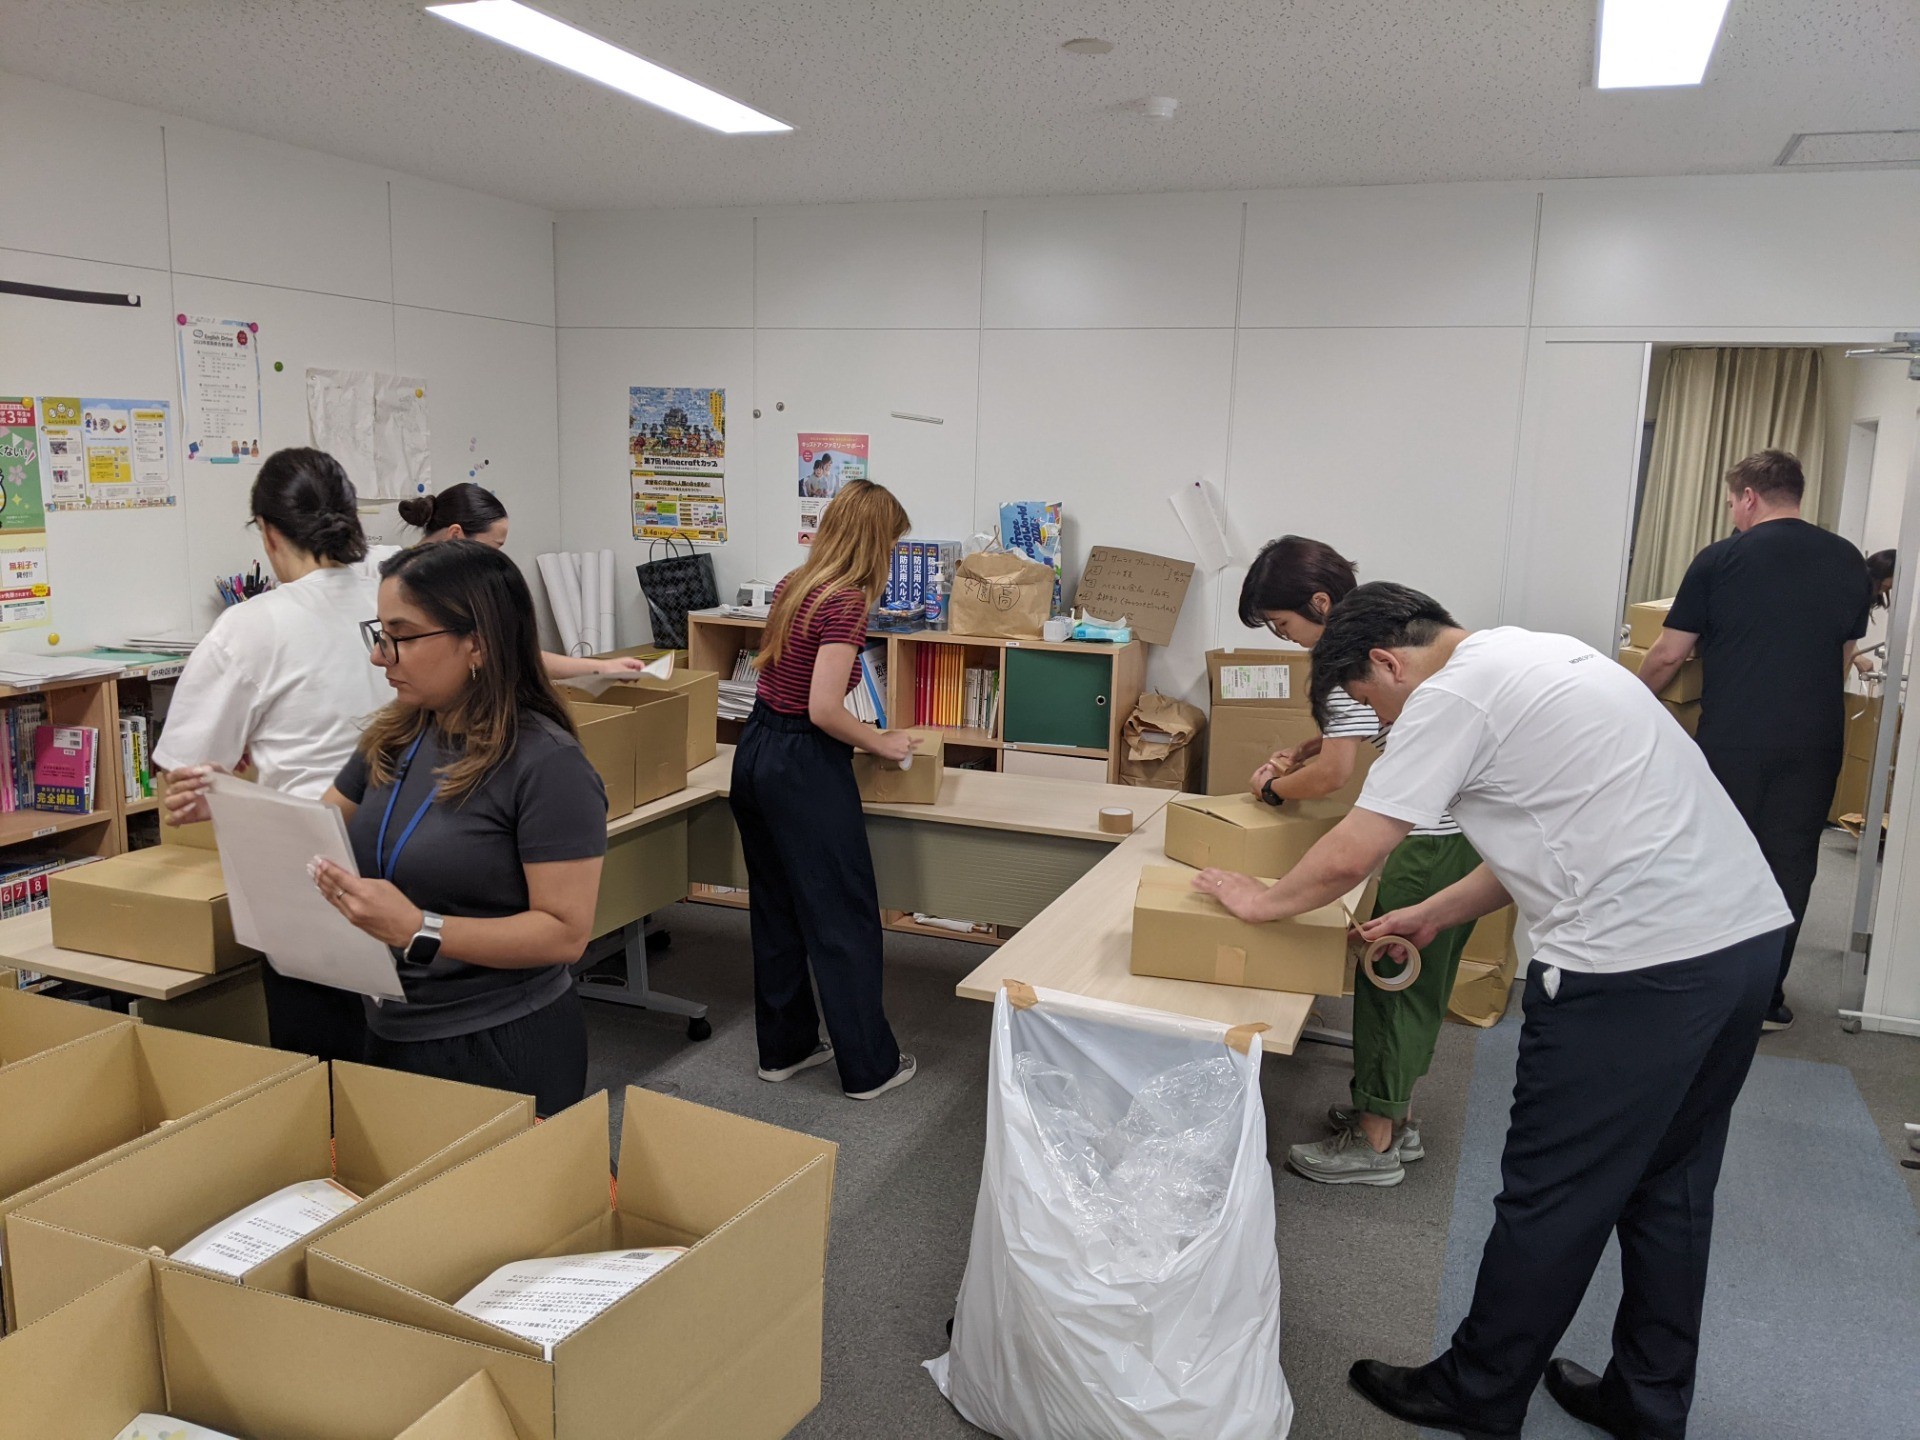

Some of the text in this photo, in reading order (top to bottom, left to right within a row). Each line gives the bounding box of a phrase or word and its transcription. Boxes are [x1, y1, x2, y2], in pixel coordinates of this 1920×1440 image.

[6, 410, 16, 424] 3
[9, 561, 39, 571] 無利子で
[37, 792, 80, 806] 完全網羅!
[15, 886, 22, 898] 7
[34, 880, 41, 892] 8
[3, 891, 10, 902] 6
